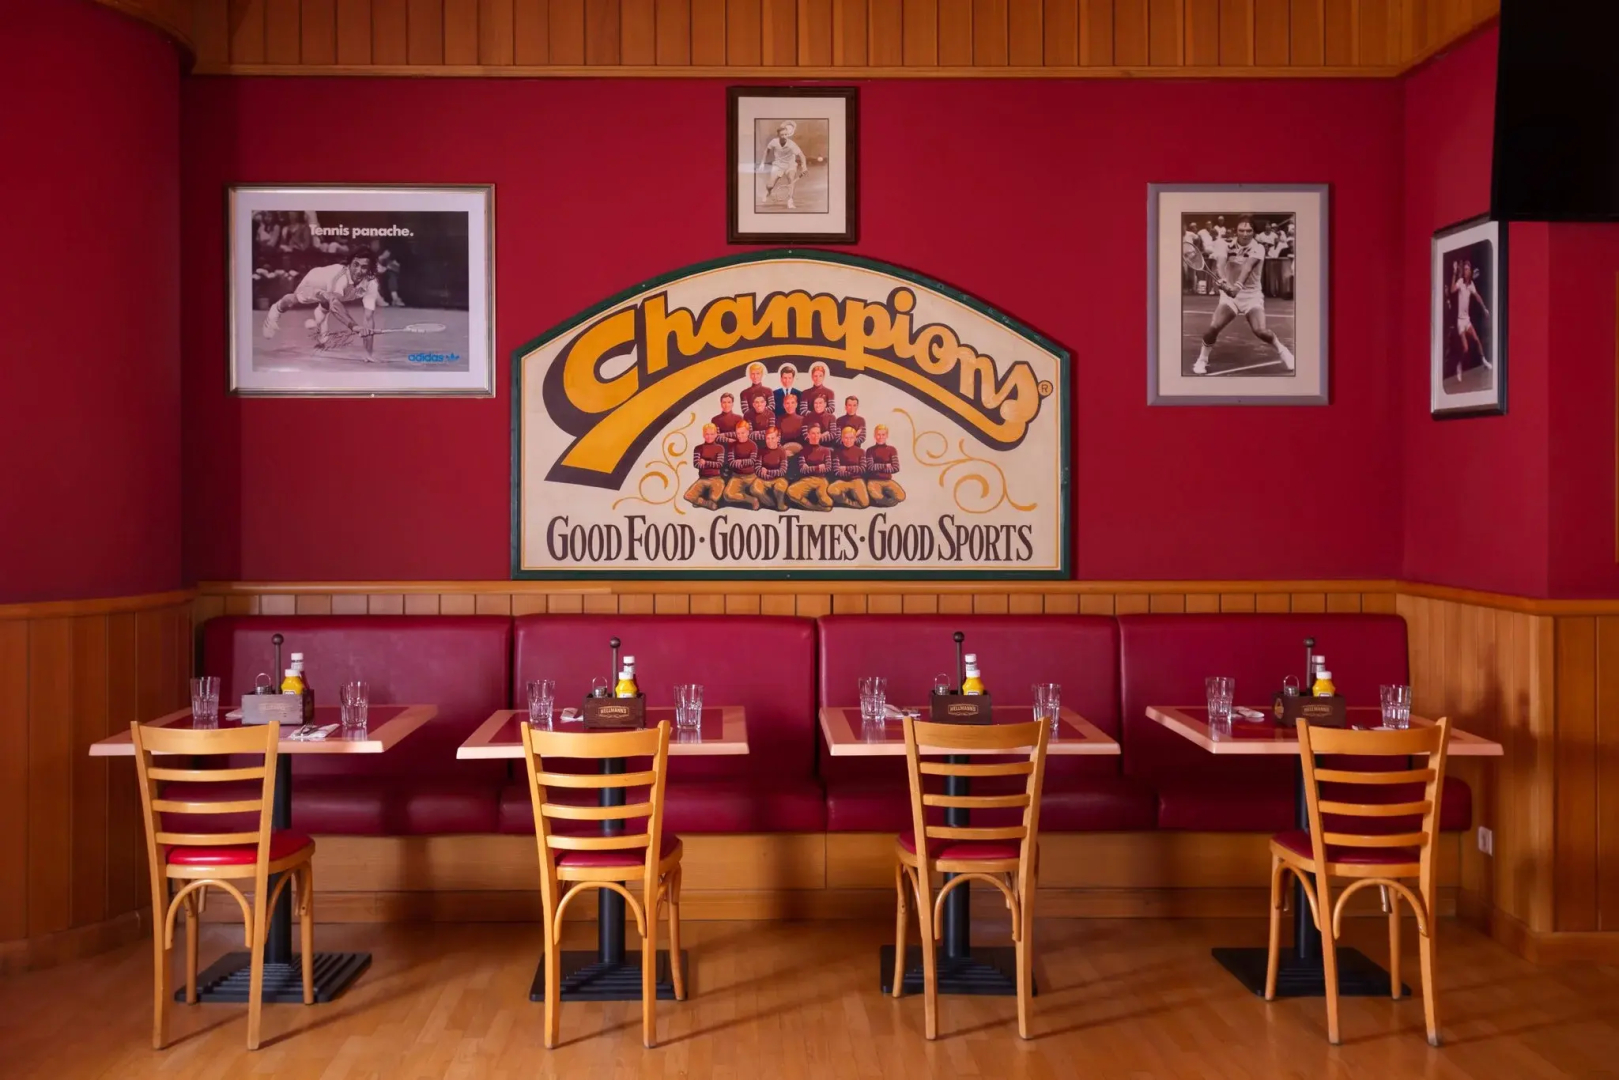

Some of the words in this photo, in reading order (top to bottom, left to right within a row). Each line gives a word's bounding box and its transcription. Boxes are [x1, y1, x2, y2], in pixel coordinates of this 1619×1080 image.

[309, 224, 350, 236] Tennis
[352, 224, 414, 239] panache.
[408, 353, 444, 362] adidas
[543, 286, 1040, 491] Champions
[938, 514, 1033, 561] SPORTS
